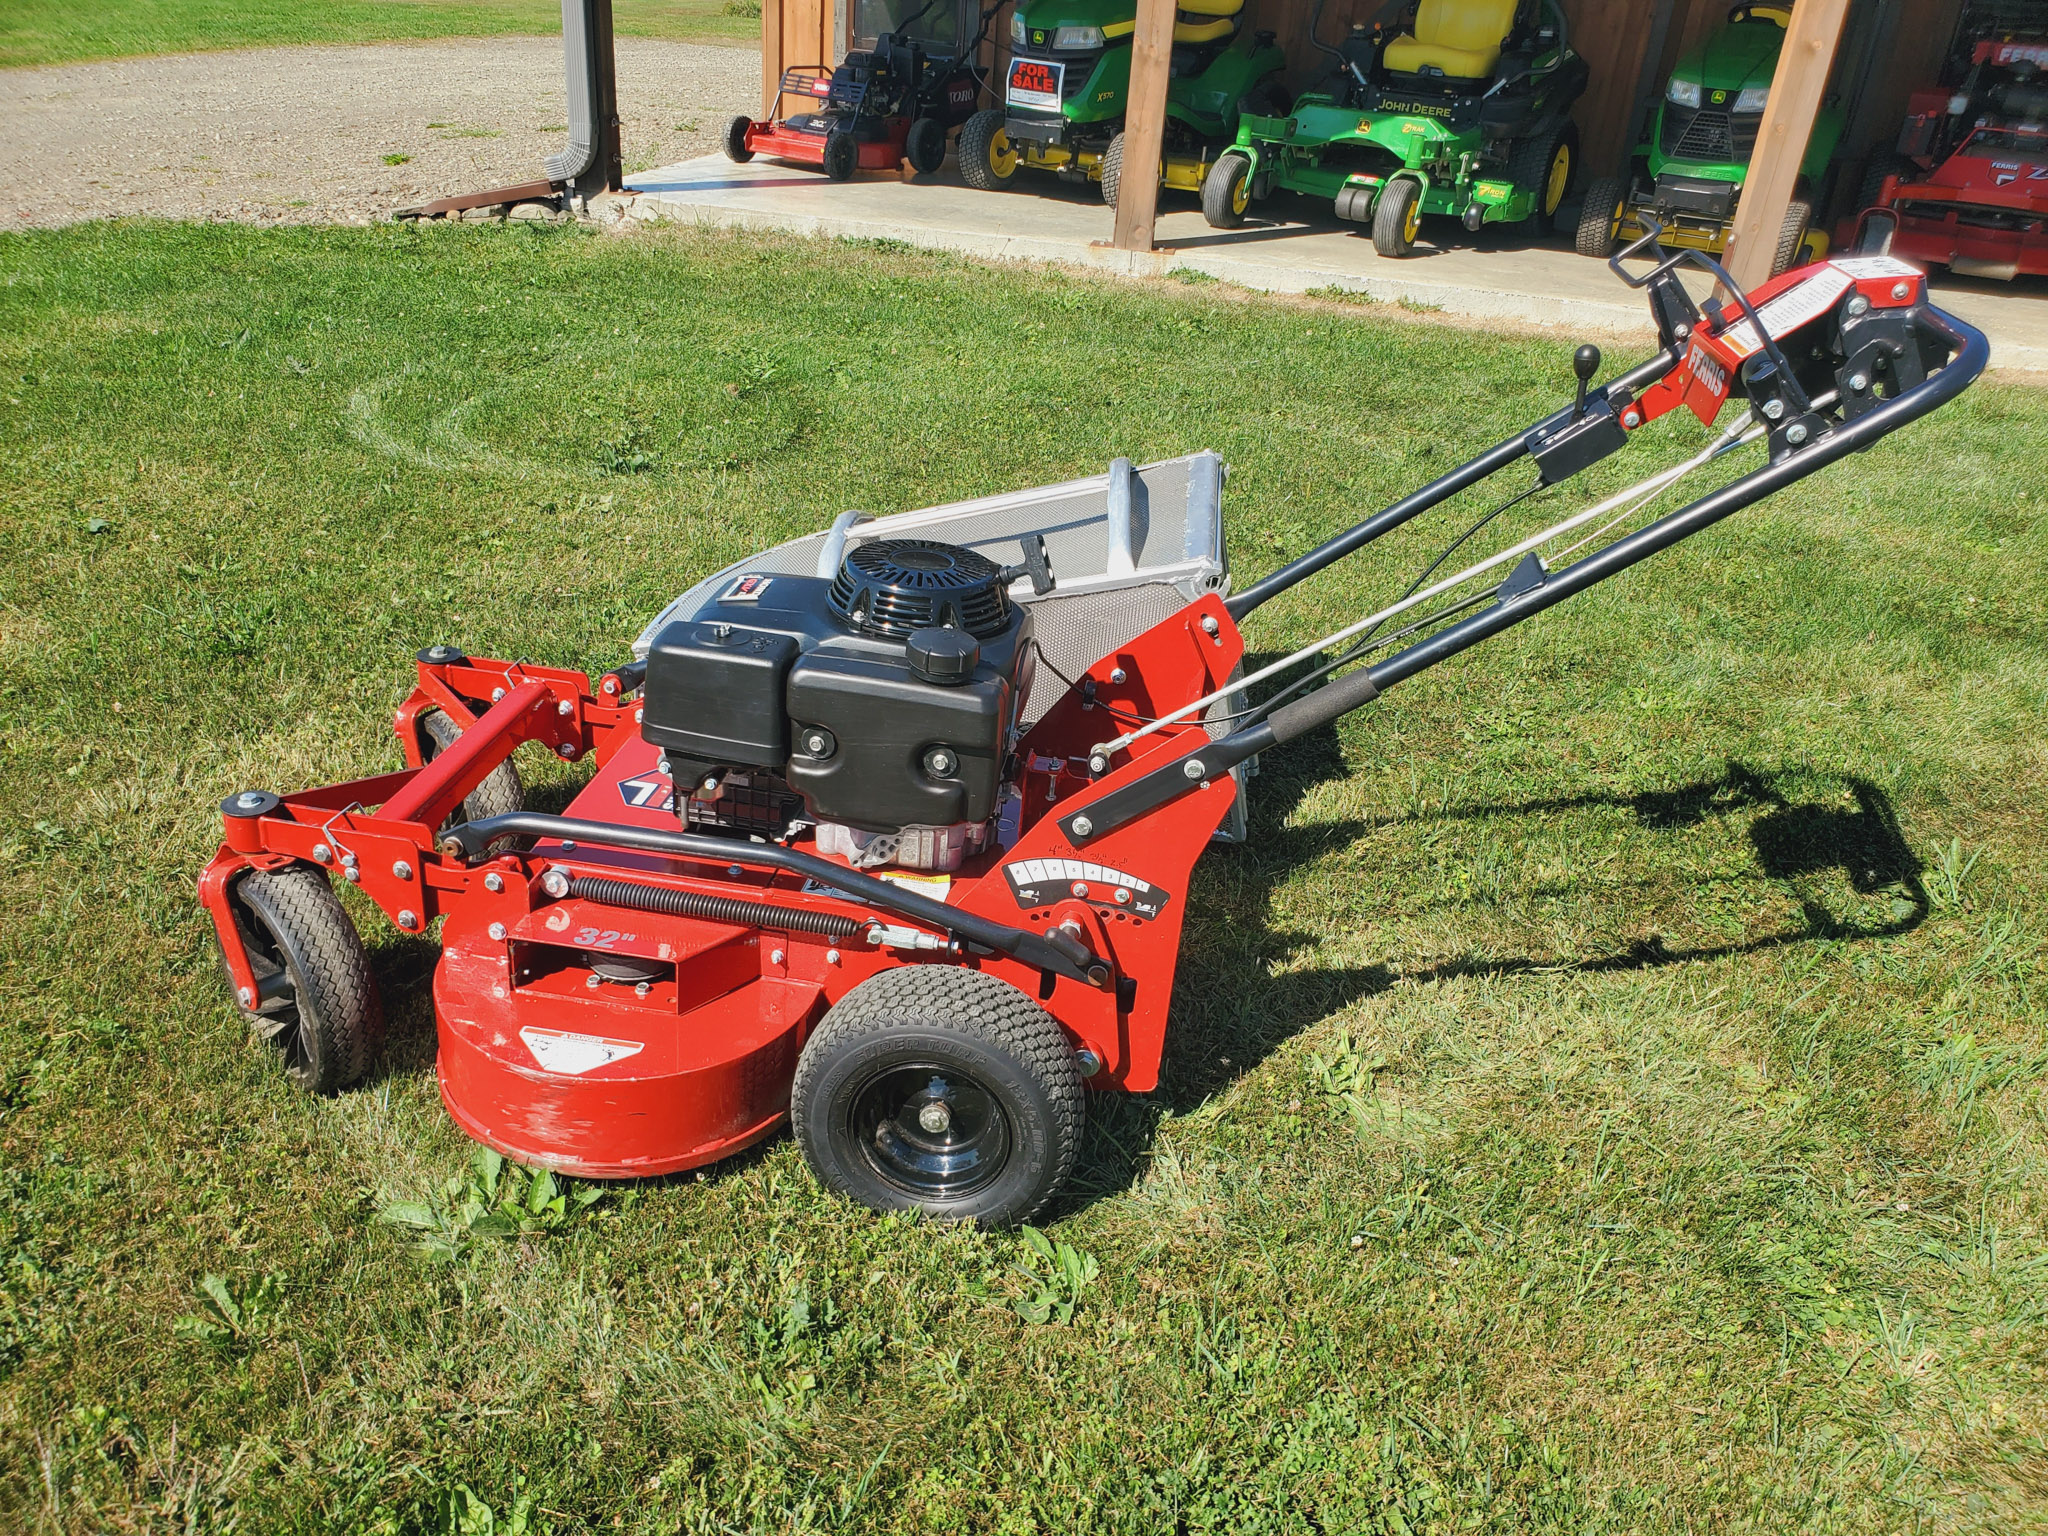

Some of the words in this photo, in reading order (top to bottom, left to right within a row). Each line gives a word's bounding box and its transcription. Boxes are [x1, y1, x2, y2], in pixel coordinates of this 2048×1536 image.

[1018, 63, 1049, 77] FOR
[1012, 73, 1054, 92] SALE
[949, 88, 974, 105] TORO
[1096, 91, 1114, 103] X570
[1378, 99, 1411, 112] JOHN
[1411, 103, 1452, 118] DEERE
[1991, 161, 2018, 171] FERRIS
[1687, 343, 1725, 397] FERRIS
[573, 927, 636, 949] 32"
[854, 1038, 920, 1065] SUPER
[927, 1039, 988, 1064] TURF
